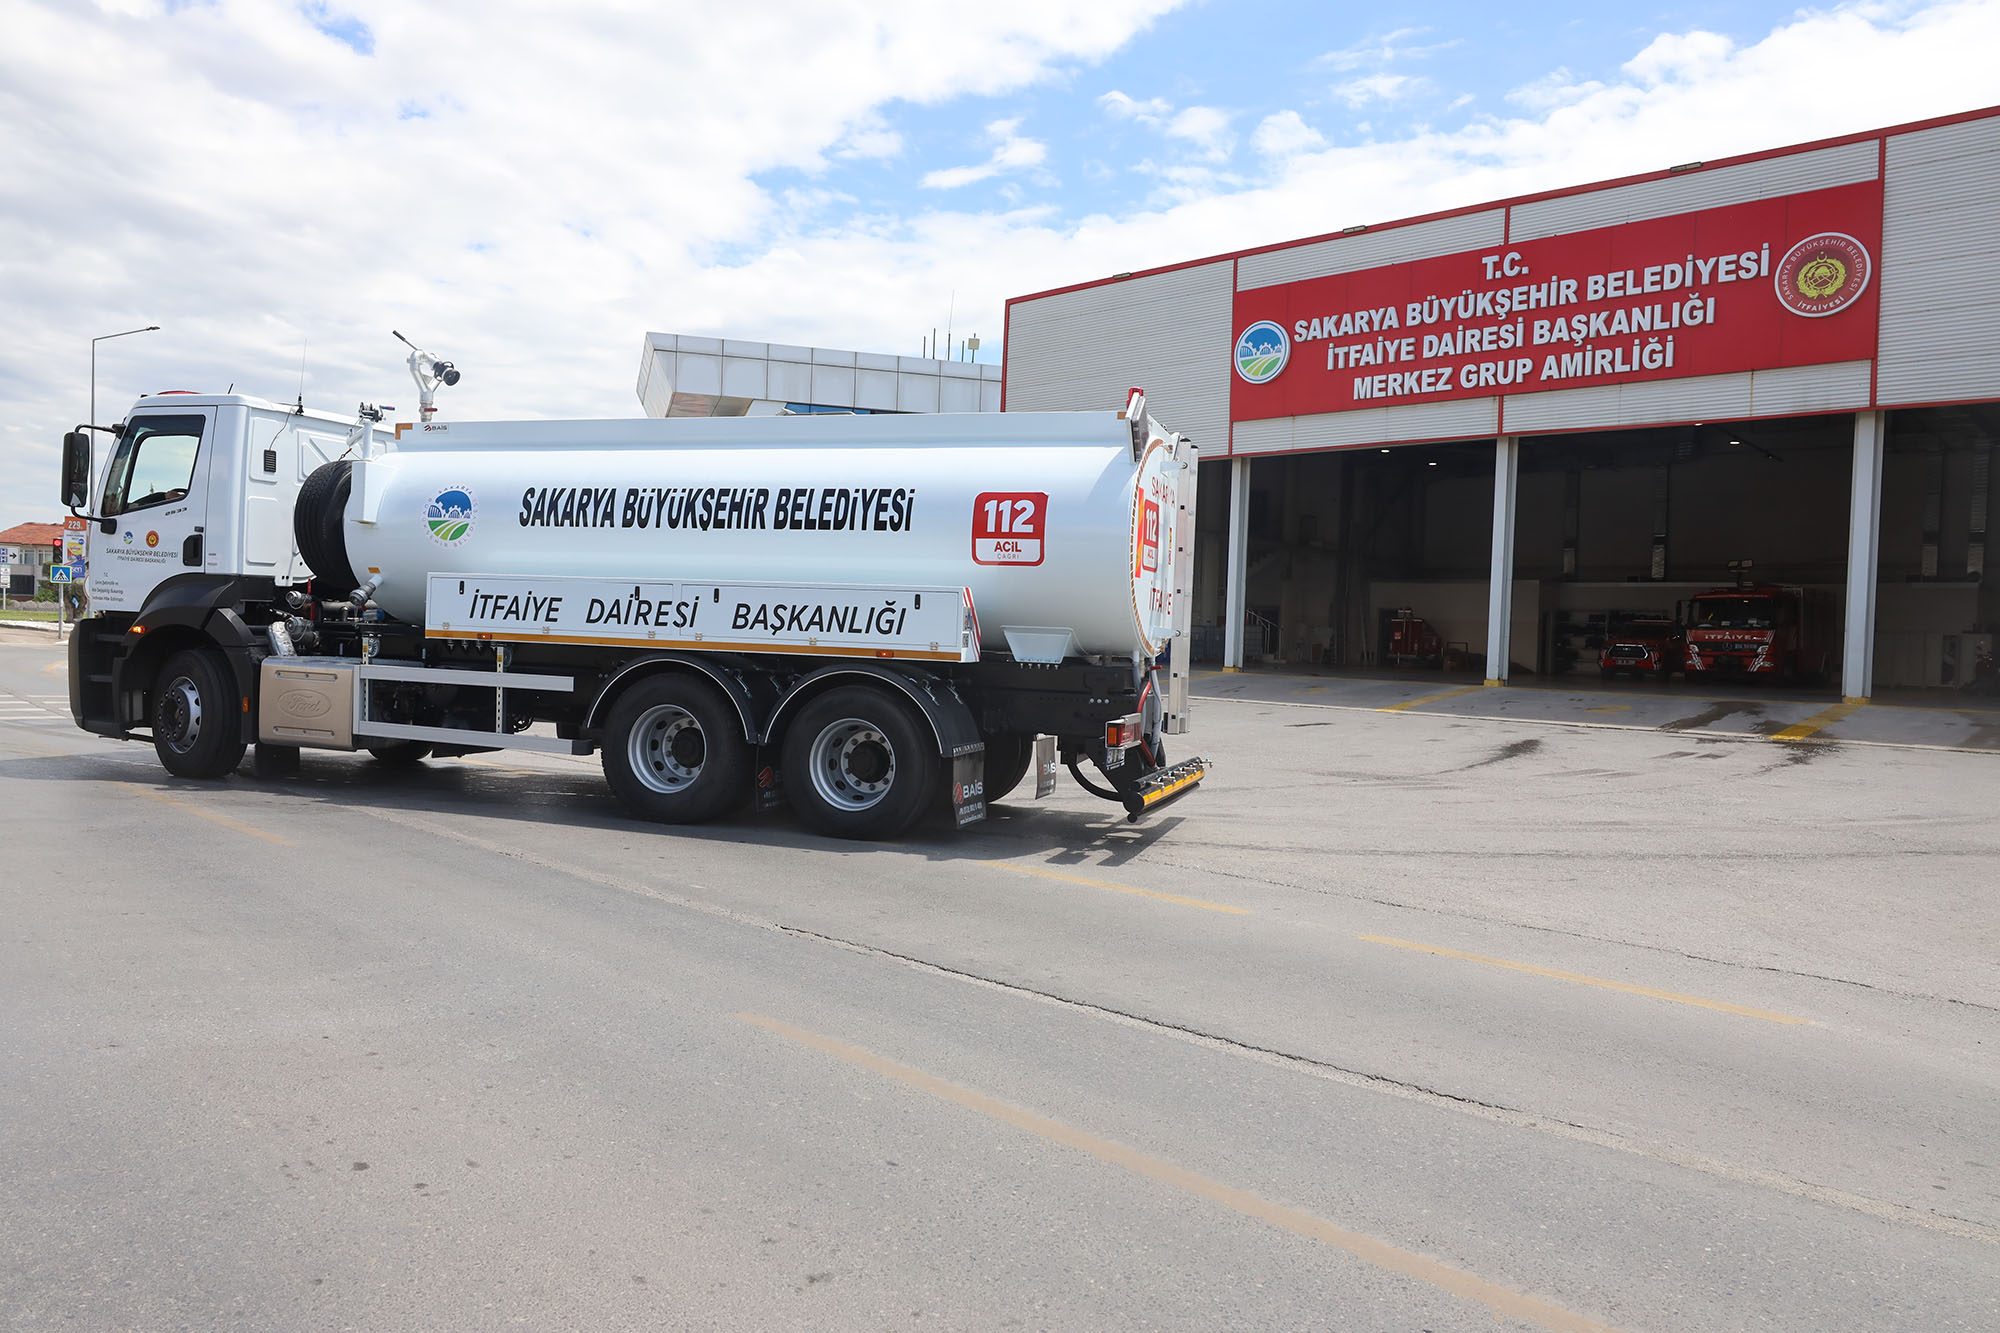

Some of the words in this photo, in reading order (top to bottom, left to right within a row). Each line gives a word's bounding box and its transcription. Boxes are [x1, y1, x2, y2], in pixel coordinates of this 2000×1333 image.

[1482, 252, 1529, 280] T.C.
[1293, 306, 1400, 342] SAKARYA
[1406, 275, 1578, 327] BÜYÜKŞEHİR
[1587, 242, 1770, 301] BELEDİYESİ
[1797, 295, 1845, 312] İTFAİYESİ
[1327, 336, 1416, 371] İTFAİYE
[1422, 316, 1524, 359] DAİRESİ
[1532, 292, 1716, 347] BAŞKANLIĞI
[1353, 367, 1454, 401] MERKEZ
[1460, 358, 1534, 390] GRUP
[1540, 335, 1675, 381] AMİRLİĞİ
[519, 487, 617, 528] SAKARYA
[621, 488, 770, 532] BÜYÜKŞEHİR
[773, 488, 916, 532] BELEDİYESİ
[984, 499, 1036, 533] 112
[1146, 508, 1157, 542] 112
[993, 541, 1022, 552] ACİL
[469, 588, 563, 623] İTFAİYE
[585, 595, 700, 628] DAİRESİ
[731, 600, 908, 636] BAŞKANLIĞI
[288, 693, 321, 713] Ford
[963, 779, 983, 799] BAİS
